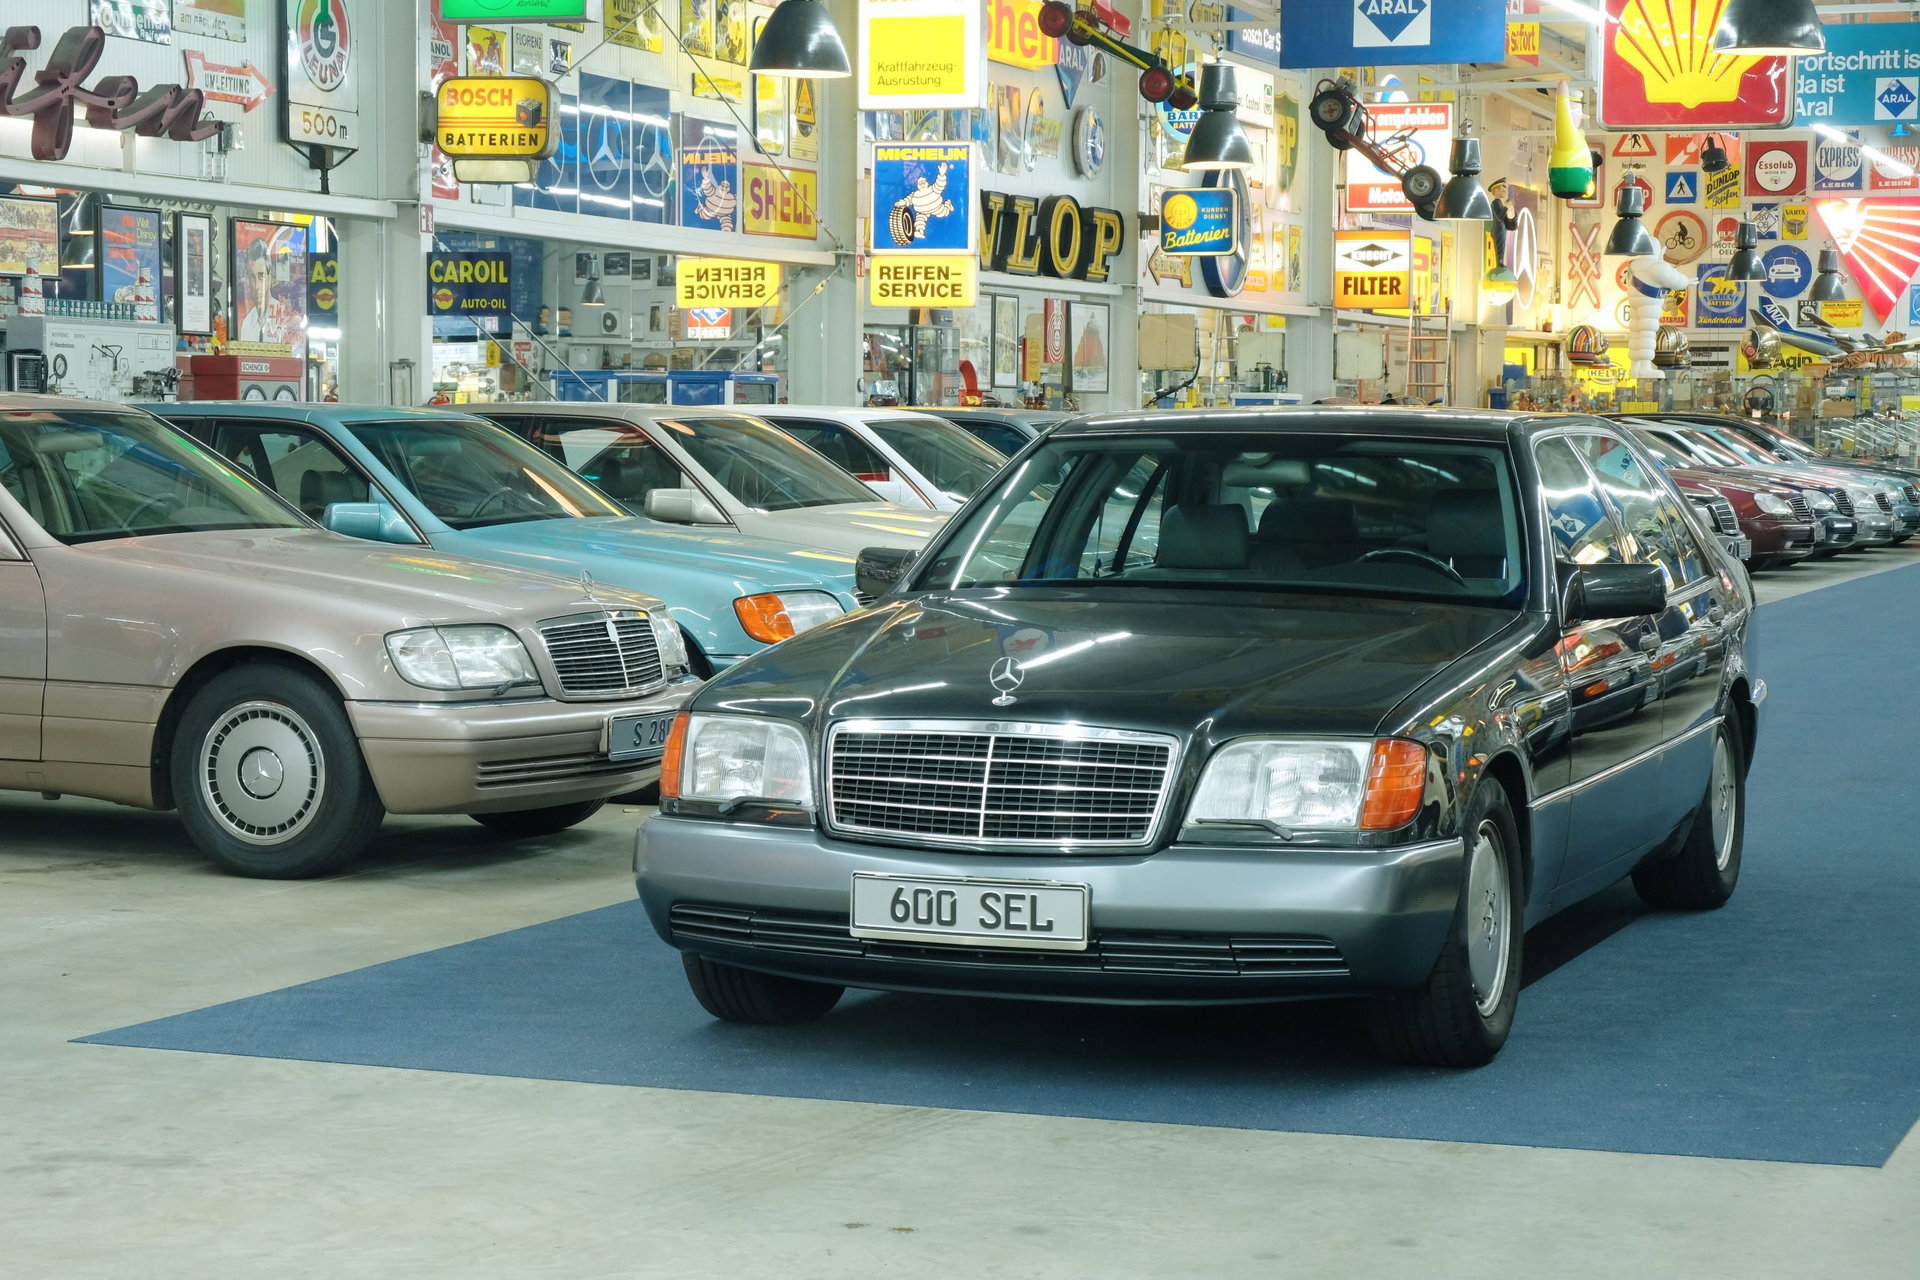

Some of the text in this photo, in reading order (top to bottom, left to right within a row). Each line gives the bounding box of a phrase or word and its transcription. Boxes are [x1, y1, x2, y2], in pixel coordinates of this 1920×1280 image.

[1366, 0, 1419, 15] ARAL
[516, 32, 543, 50] FLORENZ
[1263, 29, 1276, 49] Car
[302, 43, 347, 84] LEUNA
[877, 61, 958, 73] Kraftfahrzeug-
[1060, 43, 1084, 71] ARAL
[204, 72, 250, 98] UMLEITUNG
[1821, 73, 1846, 93] ist
[446, 88, 512, 107] BOSCH
[1881, 94, 1912, 104] ARAL
[302, 111, 348, 139] 500 m
[1377, 108, 1446, 129] empfehlen
[446, 133, 539, 146] BATTERIEN
[877, 148, 968, 161] MICHELIN
[1819, 146, 1859, 168] EXPRESS
[1758, 160, 1794, 170] Essolub
[1706, 169, 1740, 195] DUNLOP
[1822, 181, 1855, 189] LESEN
[750, 176, 812, 225] SHELL
[1785, 208, 1806, 216] VARTA
[1163, 226, 1231, 250] Batterien
[429, 260, 508, 283] CAROIL
[878, 283, 963, 298] SERVICE
[1343, 276, 1402, 295] FILTER
[1762, 302, 1786, 326] ANA
[242, 363, 264, 372] SCHENCK
[633, 720, 643, 747] S
[890, 886, 1054, 932] 600 SEL
